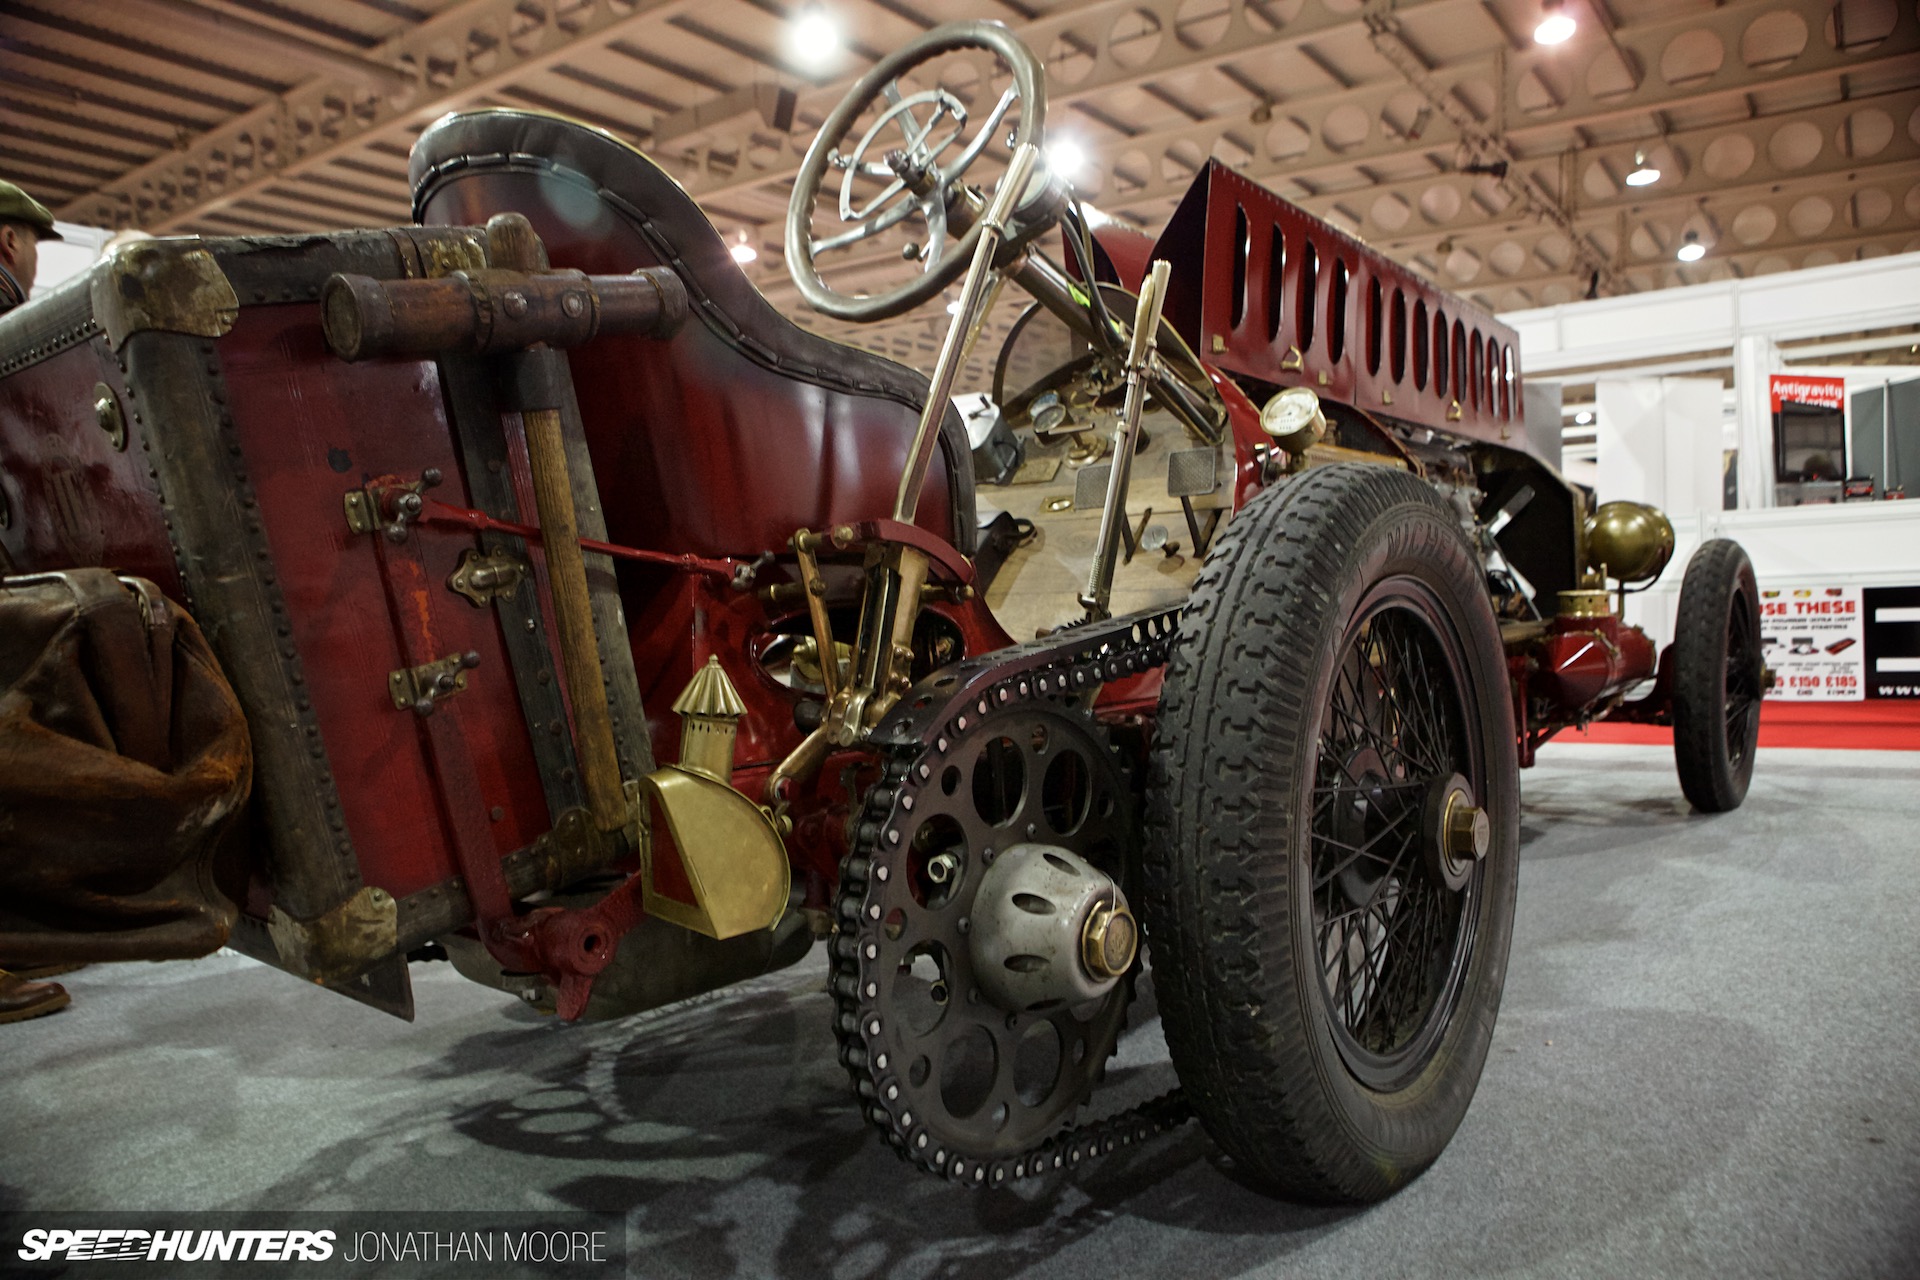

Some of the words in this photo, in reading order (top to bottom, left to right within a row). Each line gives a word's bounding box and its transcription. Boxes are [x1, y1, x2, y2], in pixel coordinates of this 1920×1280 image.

[1772, 380, 1842, 400] Antigravity
[1794, 600, 1856, 614] THESE
[1825, 675, 1857, 687] £185
